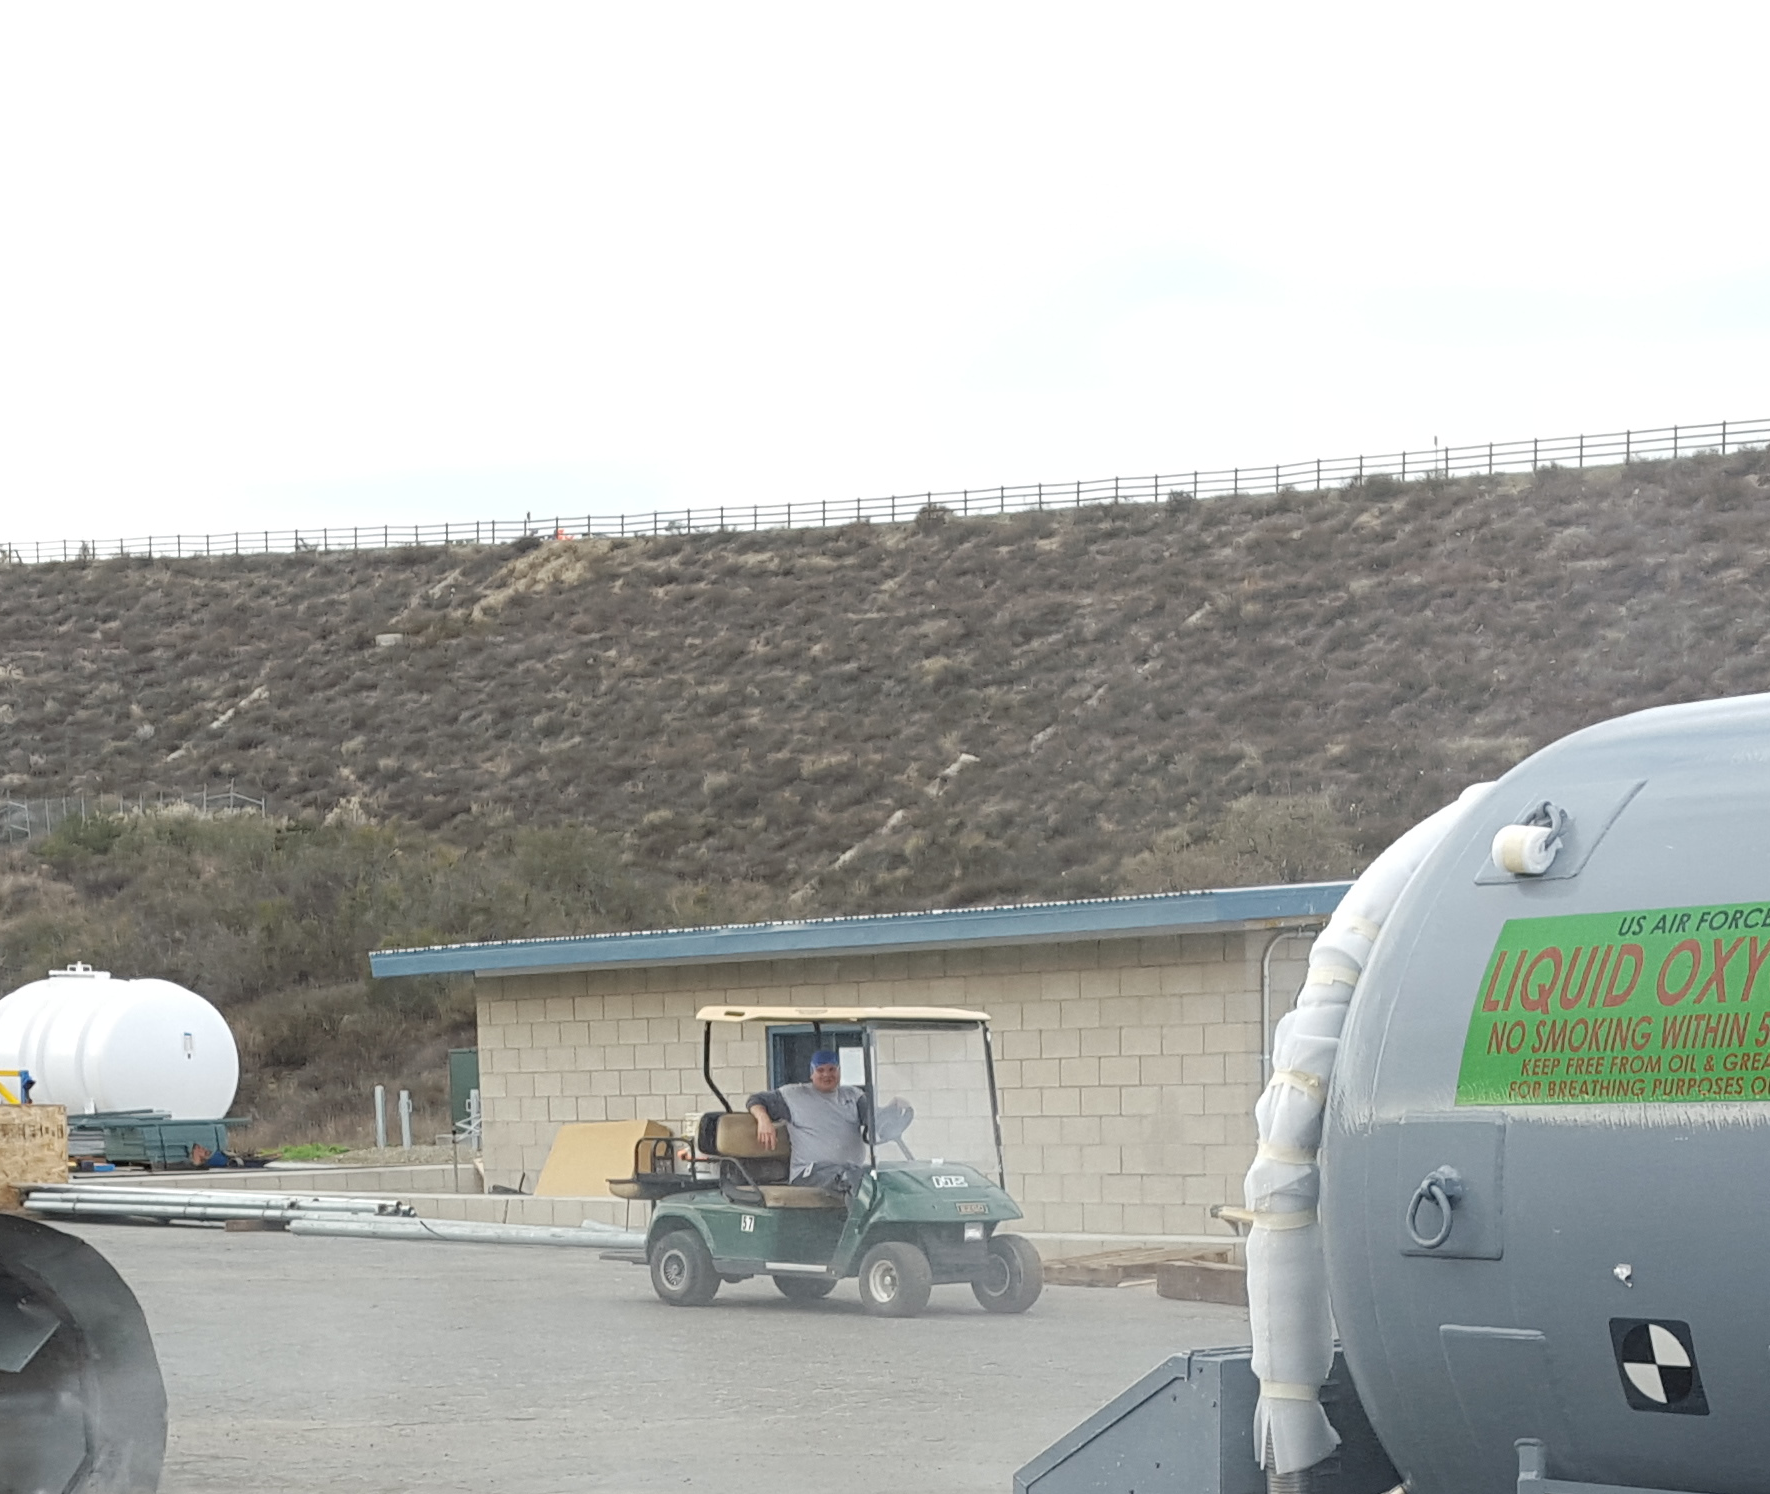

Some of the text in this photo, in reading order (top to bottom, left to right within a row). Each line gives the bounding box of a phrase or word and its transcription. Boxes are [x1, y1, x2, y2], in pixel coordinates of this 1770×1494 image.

[1618, 916, 1647, 936] US
[1650, 913, 1691, 935] AIR
[1482, 943, 1644, 1014] LIQUID
[1486, 1020, 1526, 1054] NO
[1531, 1016, 1653, 1053] SMOKING
[1661, 1012, 1750, 1050] WITHIN
[1521, 1057, 1561, 1077] KEEP
[1566, 1056, 1605, 1075] FREE
[1609, 1055, 1661, 1075] FROM
[1668, 1054, 1696, 1073] OIL
[1703, 1054, 1715, 1073] &
[1508, 1080, 1541, 1099] FOR
[1547, 1078, 1645, 1098] BREATHING
[1652, 1075, 1744, 1096] PURPOSES
[743, 1215, 753, 1231] 57
